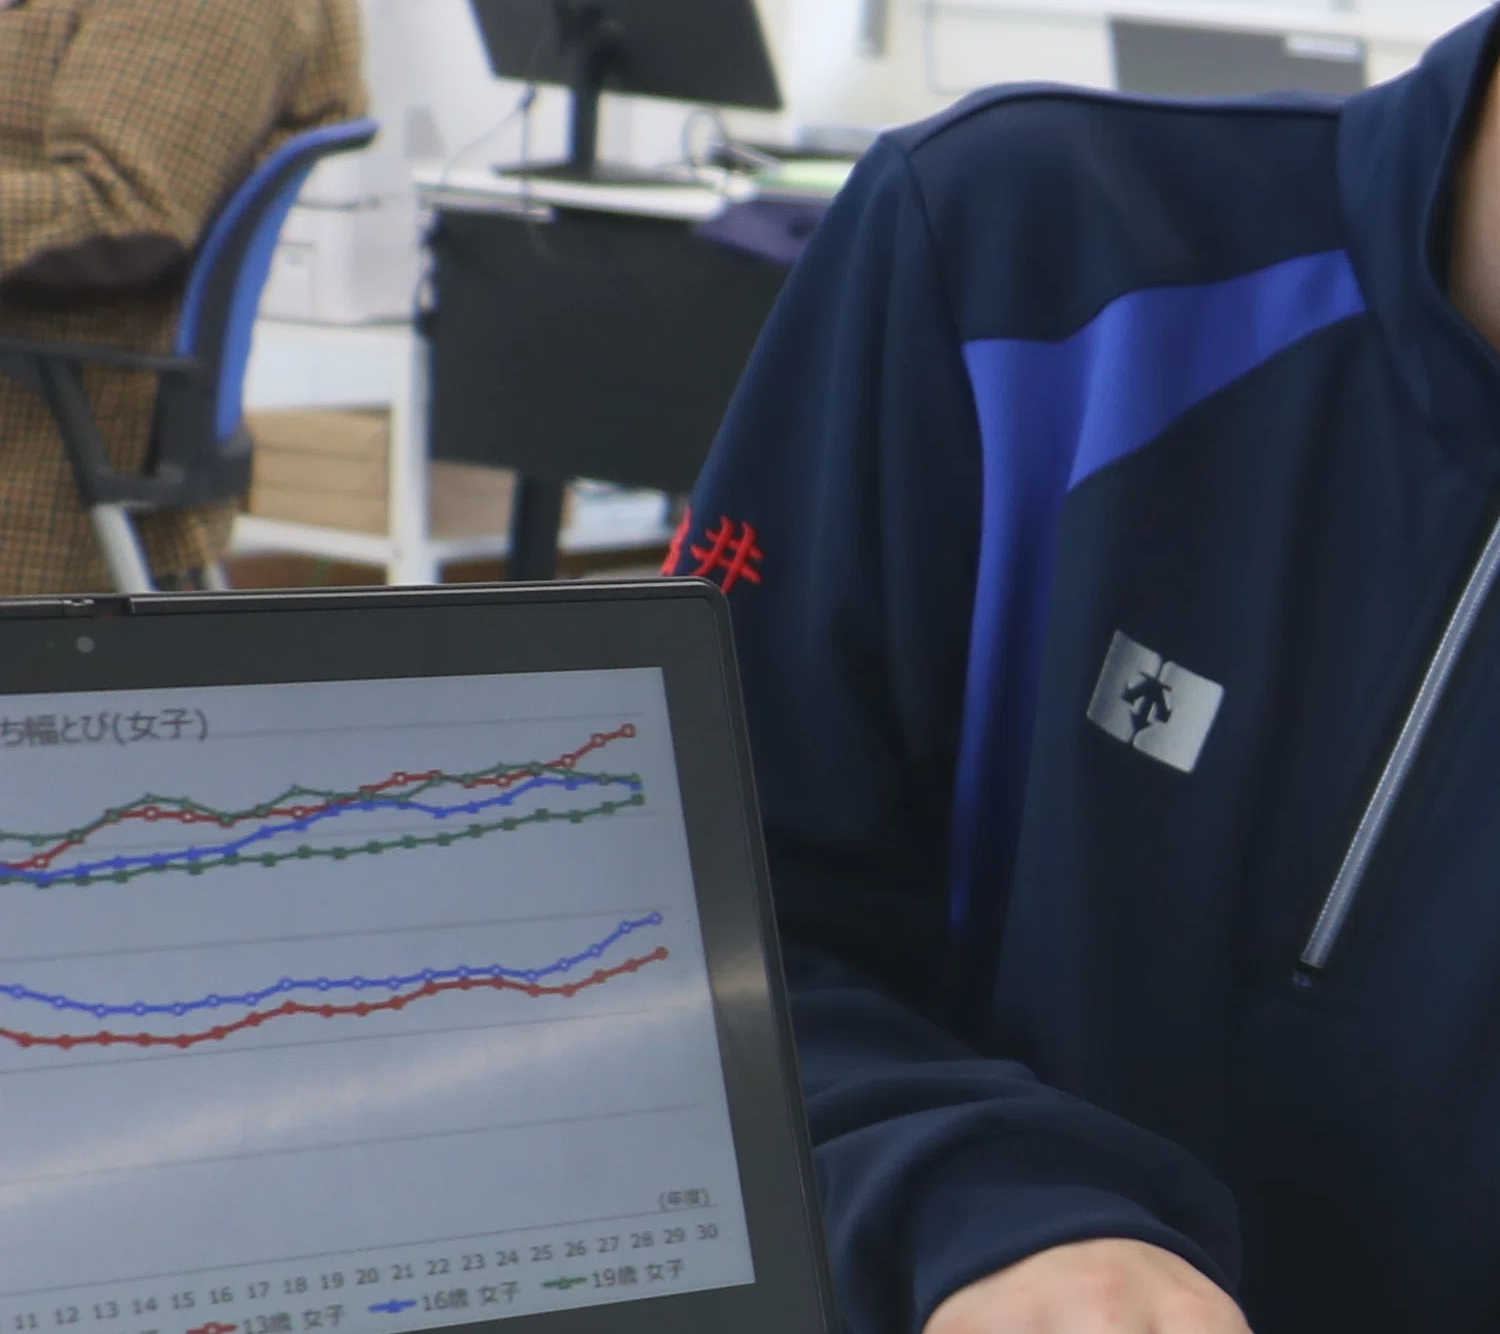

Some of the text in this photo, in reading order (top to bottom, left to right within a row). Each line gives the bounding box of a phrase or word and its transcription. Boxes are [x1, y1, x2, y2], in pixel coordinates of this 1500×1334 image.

[15, 1223, 718, 1331] 11 12 13 14 15 16 17 18 19 20 21 22 23 24 25 26 27 28 29 30
